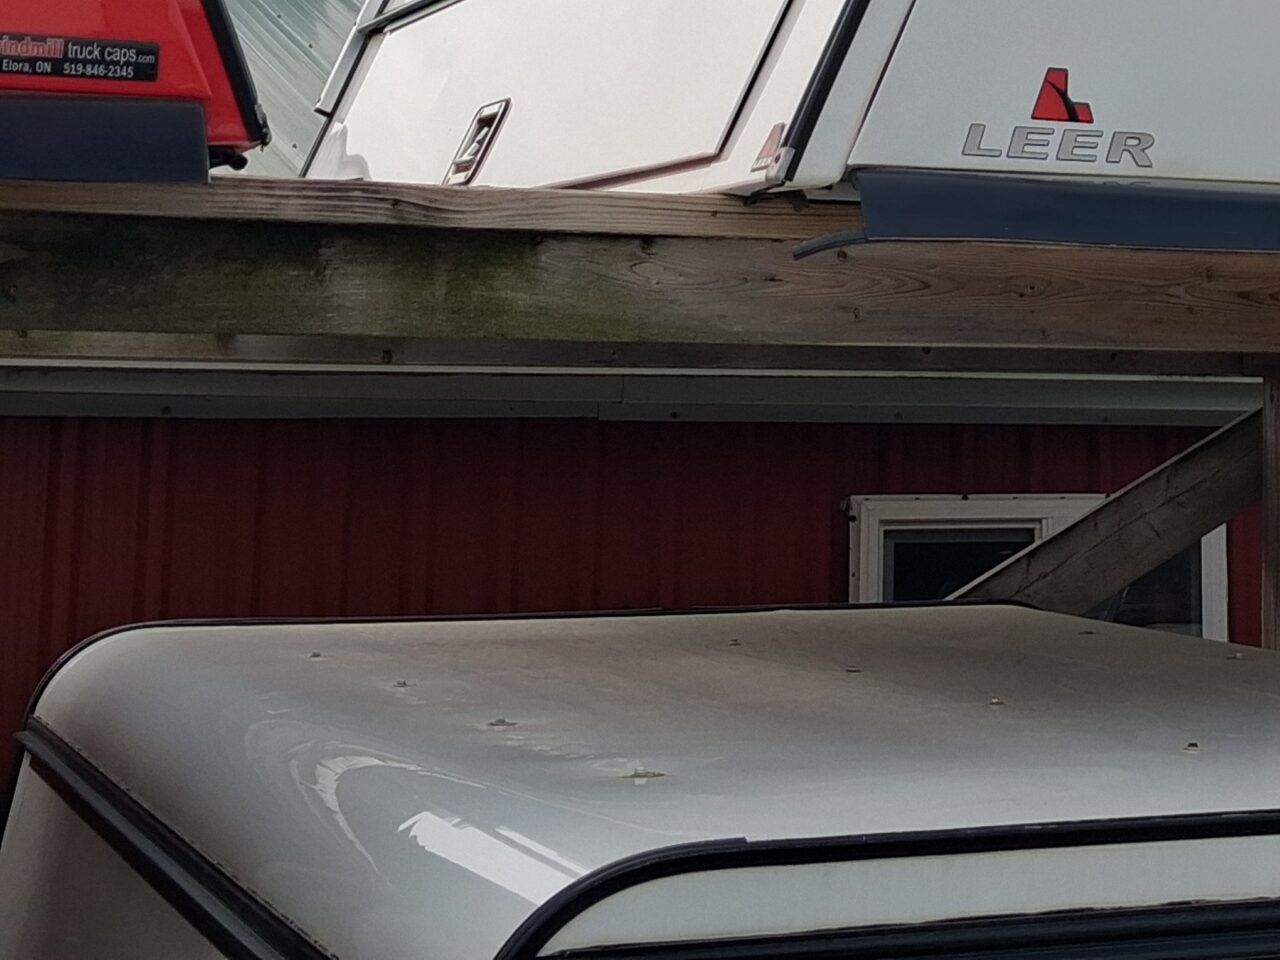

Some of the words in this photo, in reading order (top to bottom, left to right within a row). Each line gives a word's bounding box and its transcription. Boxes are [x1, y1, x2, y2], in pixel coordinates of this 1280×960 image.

[0, 36, 64, 58] indmill
[68, 42, 101, 59] truck
[2, 59, 32, 73] Elora,
[36, 61, 51, 73] ON
[63, 62, 134, 78] 519-846-2345
[961, 123, 1155, 168] LEER
